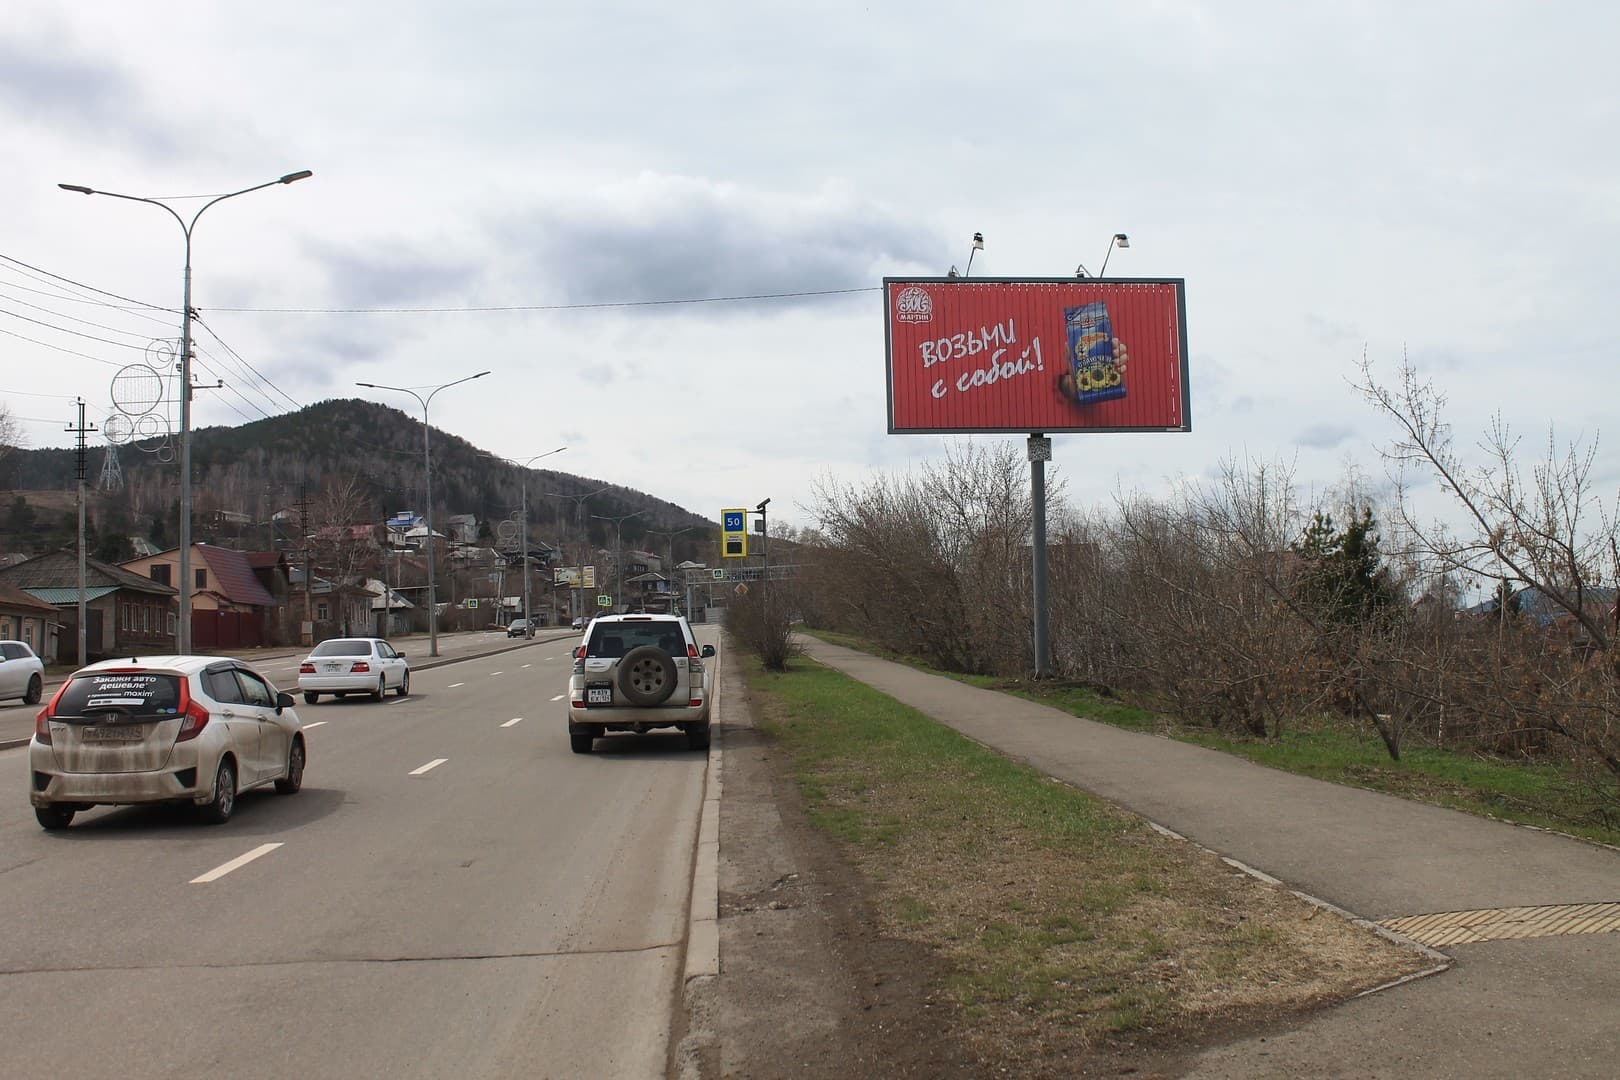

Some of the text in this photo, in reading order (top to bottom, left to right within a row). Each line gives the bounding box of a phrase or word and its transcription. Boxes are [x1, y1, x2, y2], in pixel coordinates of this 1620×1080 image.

[919, 318, 1016, 368] ВОЗЬМИ
[931, 336, 1044, 398] с собой!
[727, 517, 740, 527] 50
[93, 676, 131, 684] Закажи
